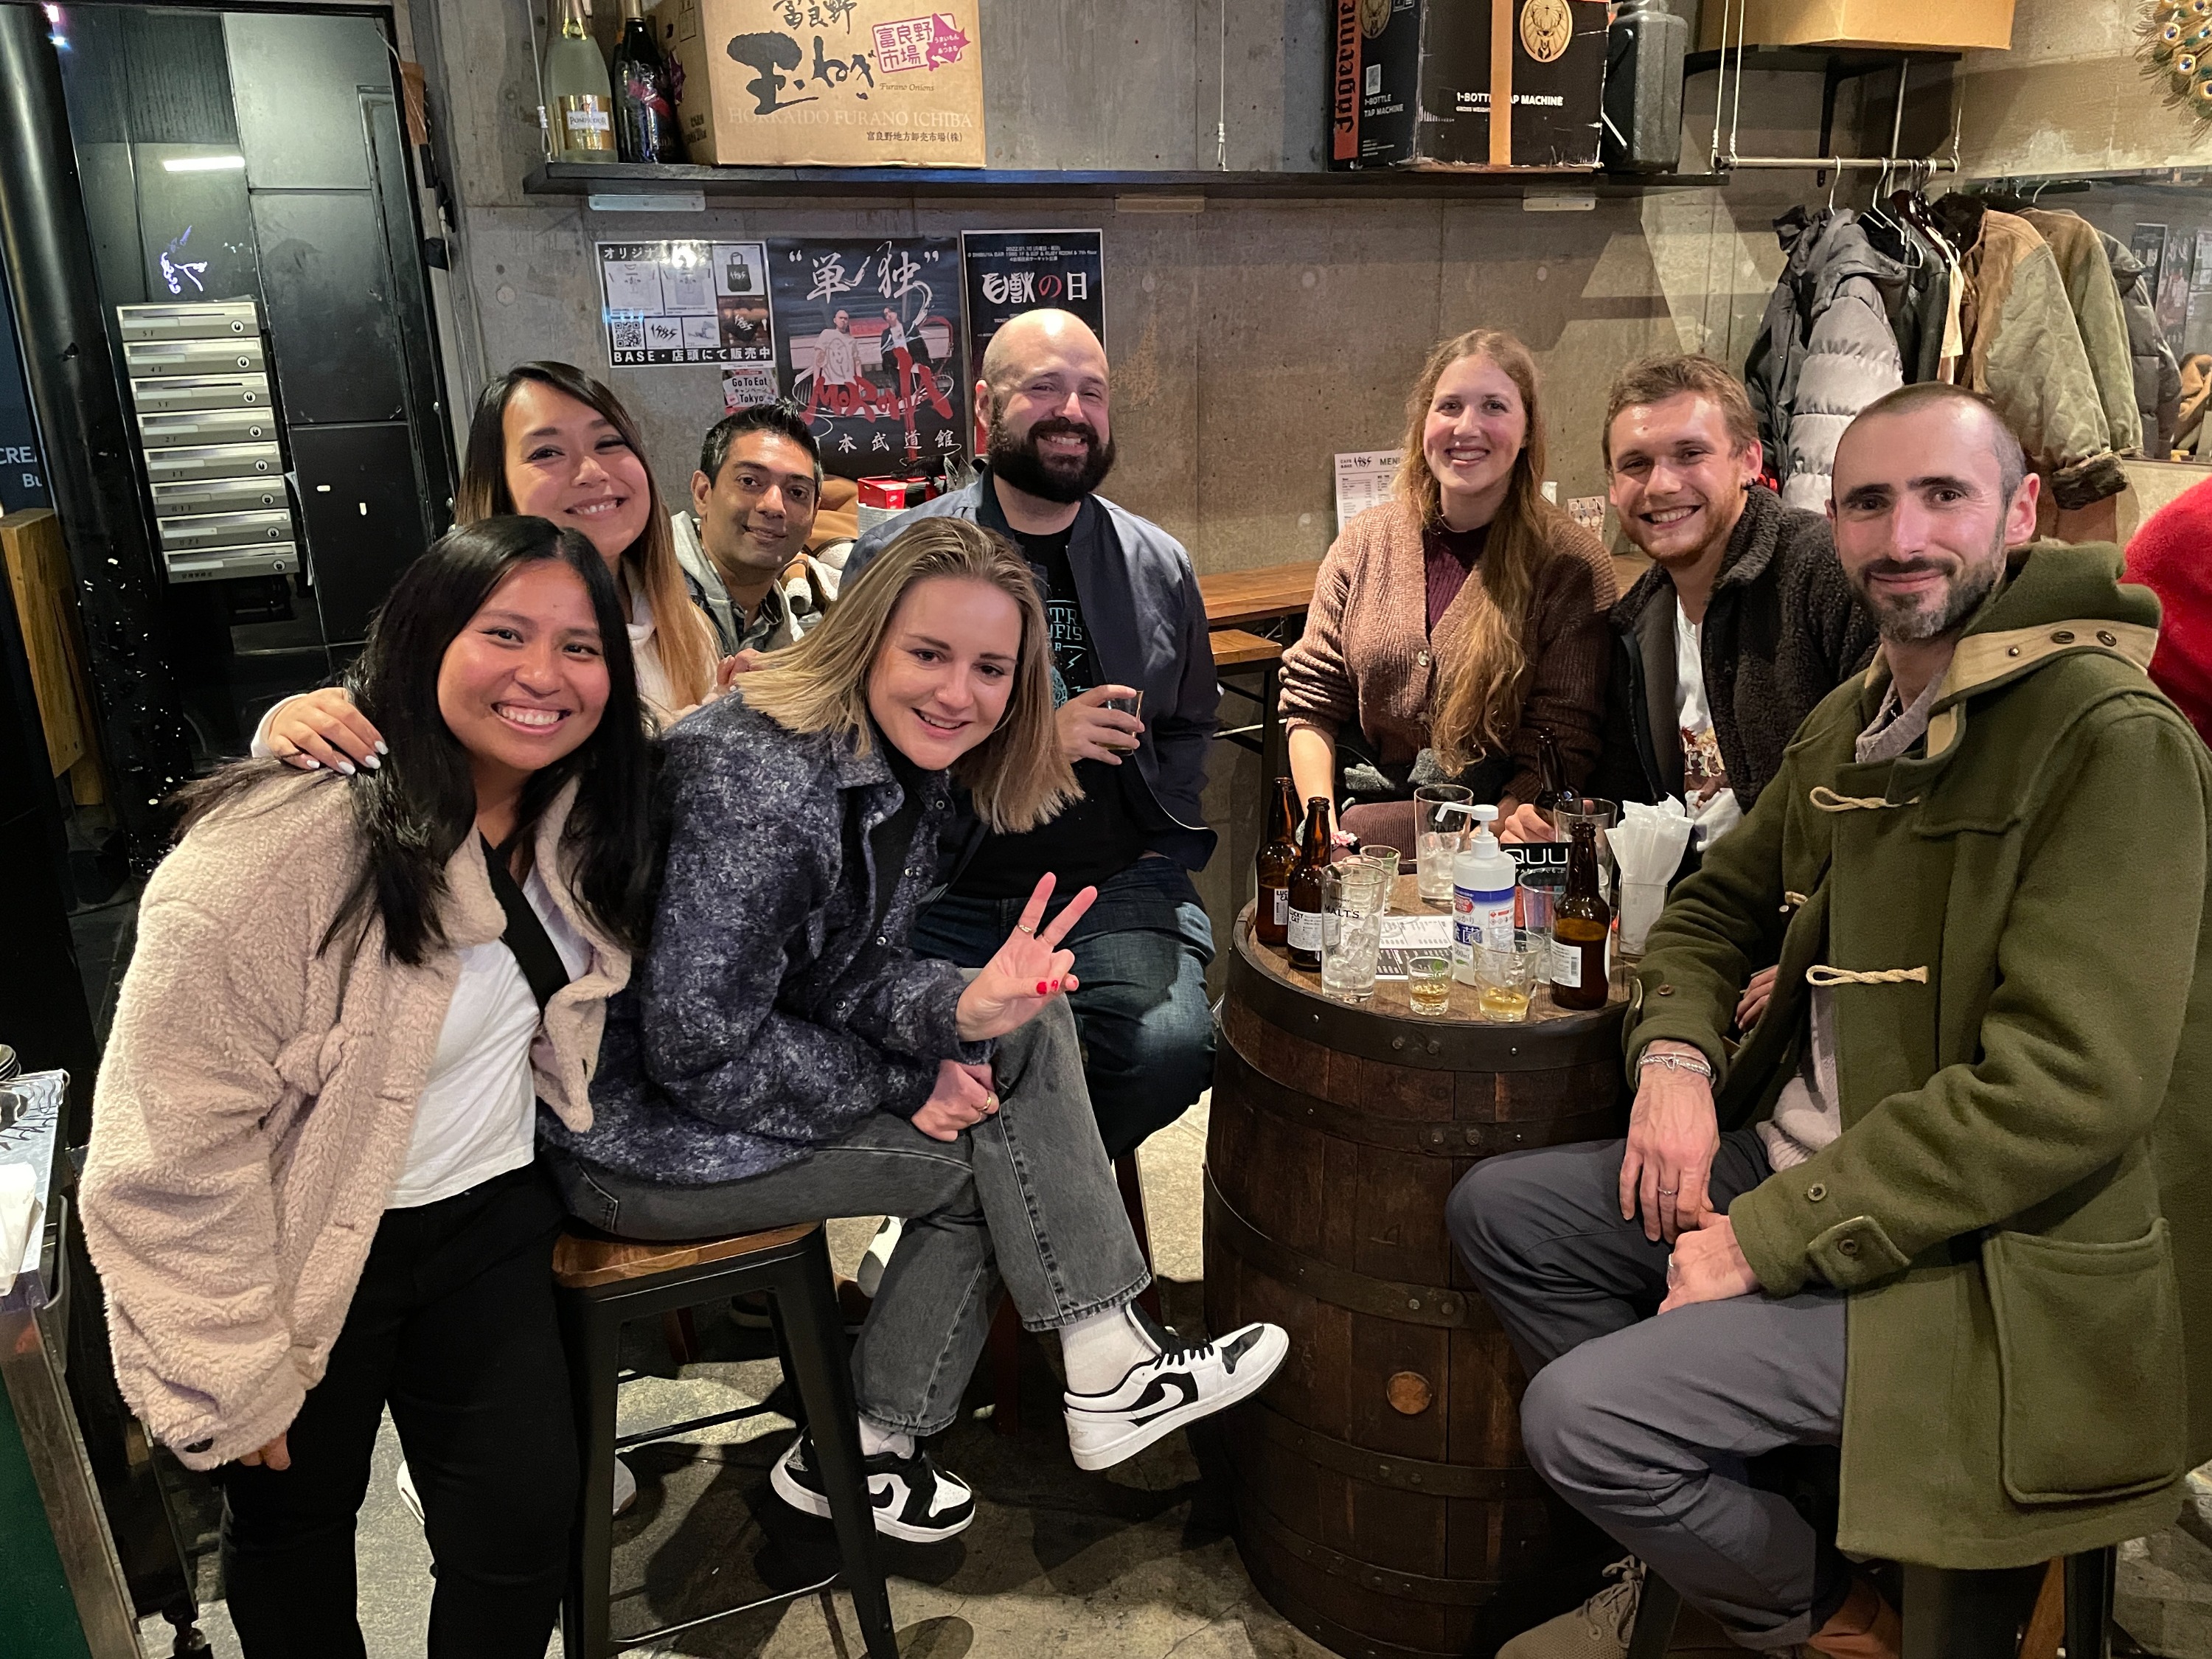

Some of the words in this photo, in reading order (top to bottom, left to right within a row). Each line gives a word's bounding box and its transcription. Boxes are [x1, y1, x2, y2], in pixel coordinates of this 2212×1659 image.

[876, 21, 932, 49] 富良野
[880, 45, 921, 69] 市場
[880, 83, 908, 91] Furano
[909, 83, 934, 91] Onions
[1364, 94, 1392, 105] 1-BOTTLE
[1457, 92, 1491, 102] 1-BOTT
[1521, 95, 1564, 106] MACHINE
[1364, 108, 1375, 117] TAP
[1377, 104, 1404, 115] MACHINE
[728, 108, 830, 126] HOKKAIDO
[835, 110, 908, 127] FURANO
[914, 112, 973, 128] ICHIBA
[732, 378, 742, 387] Go
[744, 378, 753, 386] To
[754, 377, 767, 386] Eat
[740, 393, 764, 403] Tokyo
[838, 429, 961, 453] 本武道館
[0, 446, 37, 465] CRE
[1380, 457, 1401, 466] MEN
[1324, 904, 1360, 919] MALT'S
[1453, 915, 1475, 925] っかり
